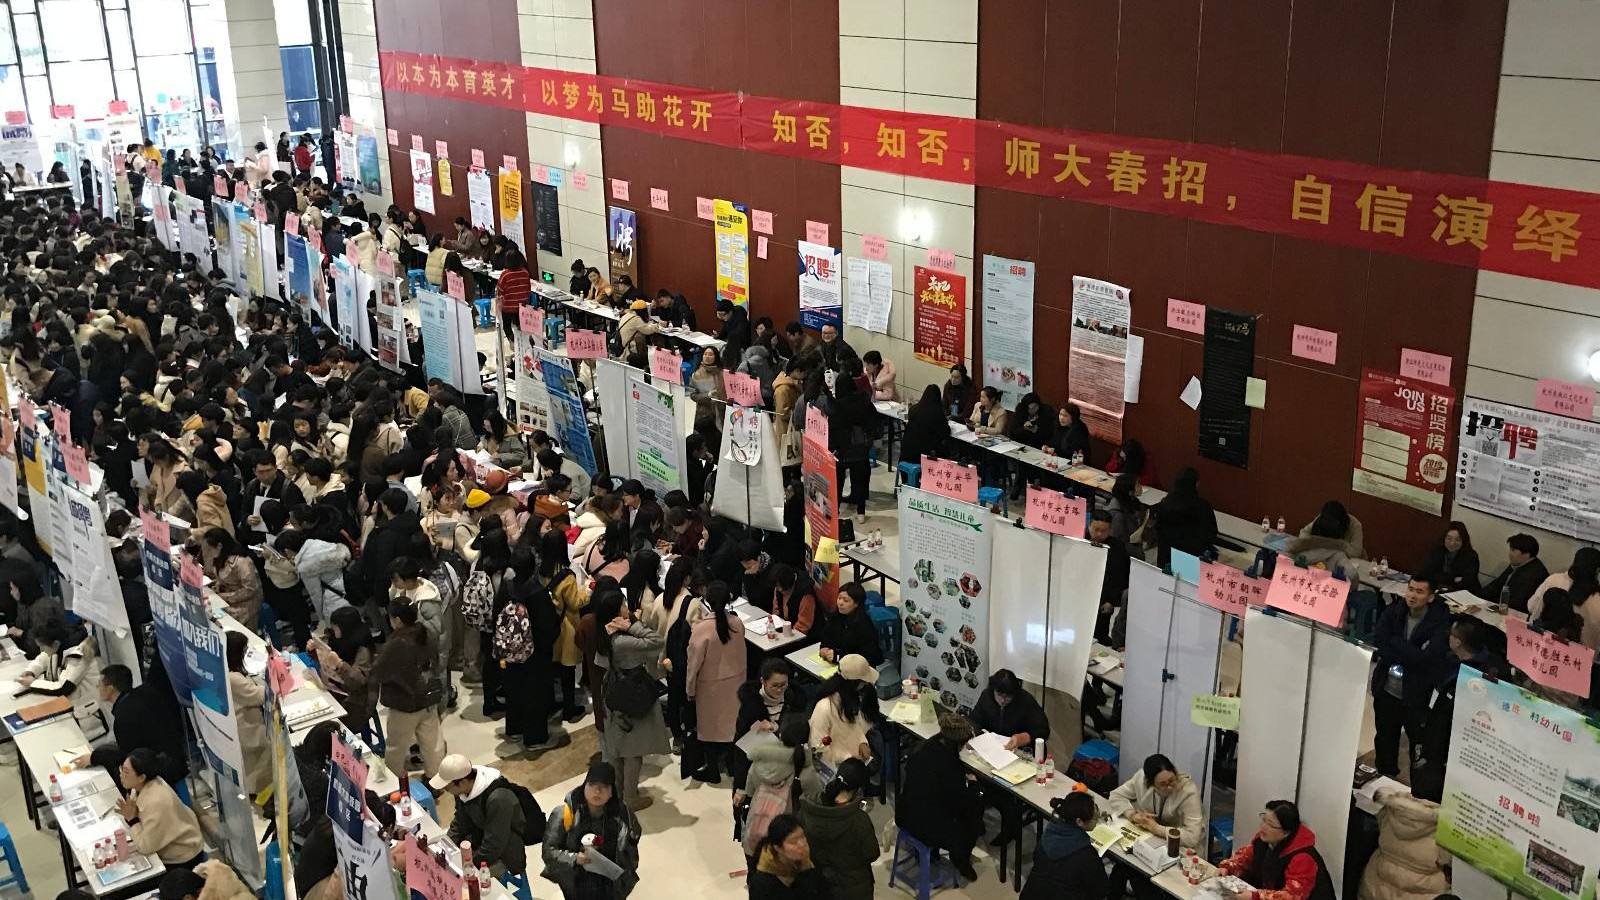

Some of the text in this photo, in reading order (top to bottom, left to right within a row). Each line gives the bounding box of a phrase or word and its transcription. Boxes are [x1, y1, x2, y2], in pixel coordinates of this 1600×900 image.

[771, 110, 1581, 262] 知否，知否，师大春招，自信演绎
[1394, 387, 1424, 402] JOIN
[1406, 399, 1425, 413] US
[936, 481, 962, 492] 幼儿园
[1042, 513, 1065, 526] 幼儿园
[1214, 589, 1248, 606] 幼儿园
[1293, 592, 1317, 607] 幼儿园
[1531, 657, 1558, 678] 幼儿园
[1498, 795, 1541, 827] 招聘啦
